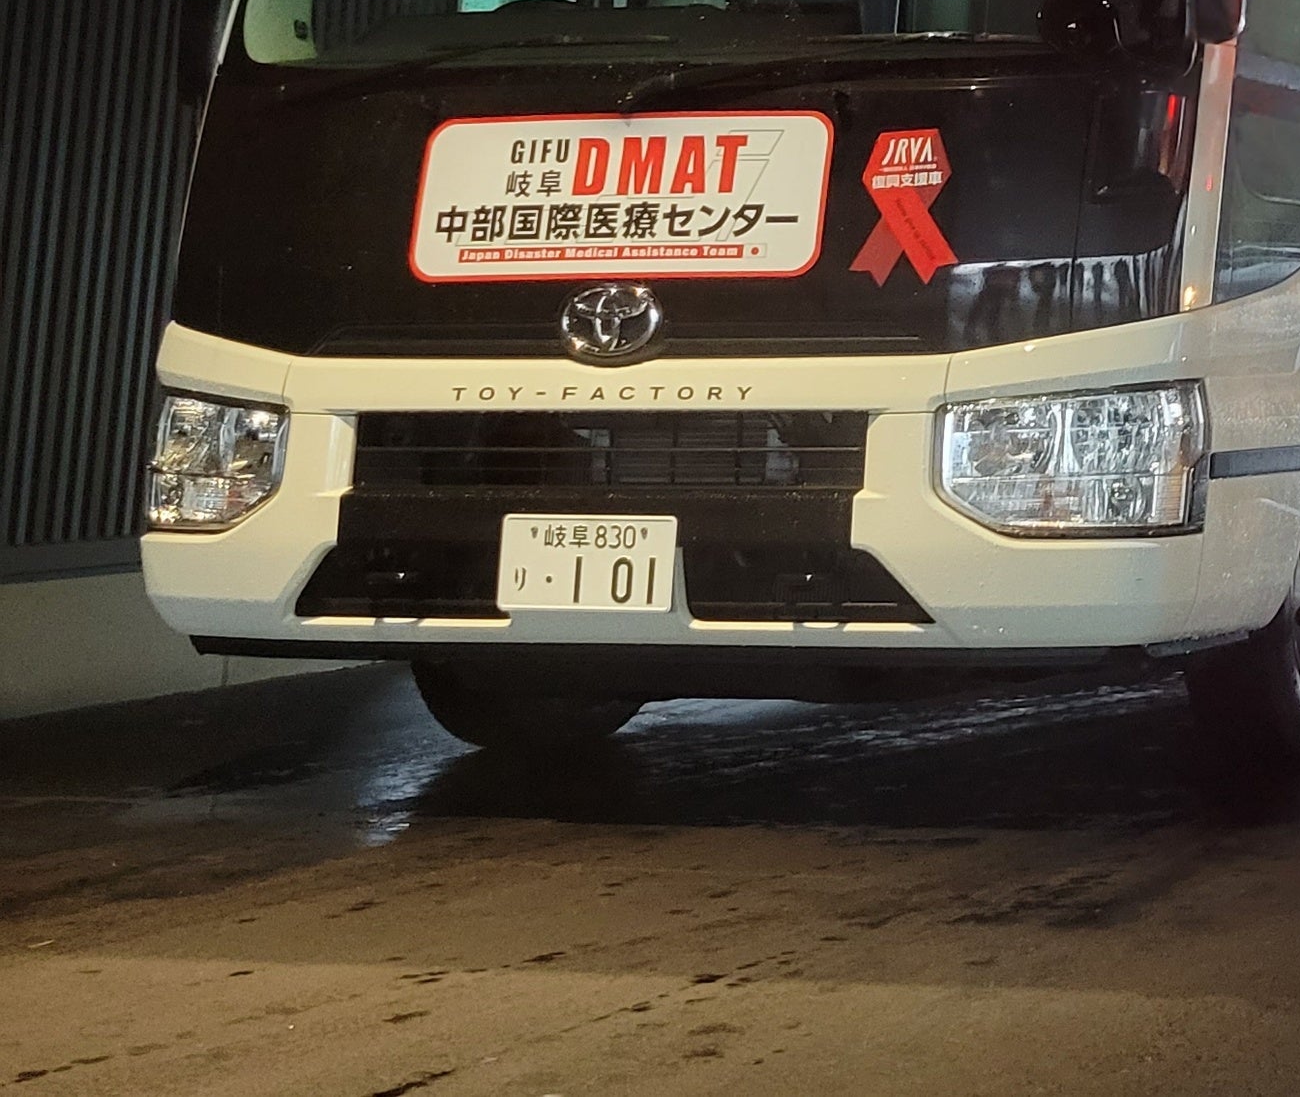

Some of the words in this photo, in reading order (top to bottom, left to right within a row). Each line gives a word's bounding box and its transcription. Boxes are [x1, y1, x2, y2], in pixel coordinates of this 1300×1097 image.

[511, 139, 570, 163] GIFU
[571, 135, 748, 195] DMAT
[505, 170, 562, 197] 岐阜
[435, 202, 799, 243] 中部国際医療センター
[461, 248, 500, 262] Japan
[504, 248, 561, 260] Disaster
[565, 247, 618, 259] Medical
[622, 246, 699, 258] Assistance
[702, 245, 739, 256] Team
[452, 386, 753, 401] TOY-FACTORY
